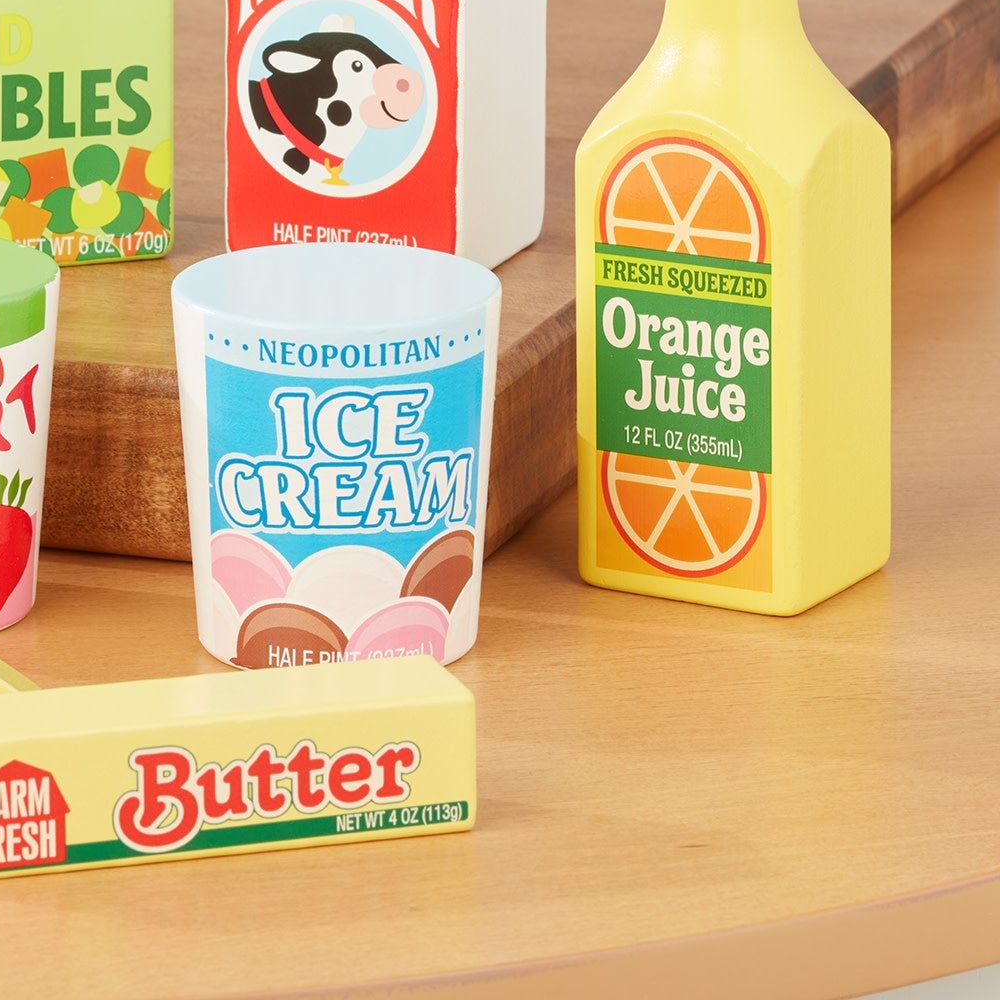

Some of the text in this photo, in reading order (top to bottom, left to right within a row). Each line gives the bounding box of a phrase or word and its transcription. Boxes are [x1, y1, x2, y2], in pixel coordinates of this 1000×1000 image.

[50, 235, 75, 256] WT
[79, 235, 89, 255] 6
[94, 234, 115, 254] OZ
[119, 229, 169, 253] (170g)
[273, 222, 313, 244] HALF
[317, 226, 351, 243] PINT
[602, 258, 768, 299] FRESH SQUEEZED
[258, 335, 442, 369] NEOPOLITAN
[602, 296, 770, 379] Orange
[624, 358, 747, 423] Juice
[273, 387, 430, 459] ICE
[624, 425, 743, 463] 12 FL OZ (355mL)
[218, 453, 473, 530] CREAM
[268, 644, 313, 667] HALF
[117, 740, 416, 848] Butter
[336, 802, 463, 832] NET WT 4 OZ (113g)
